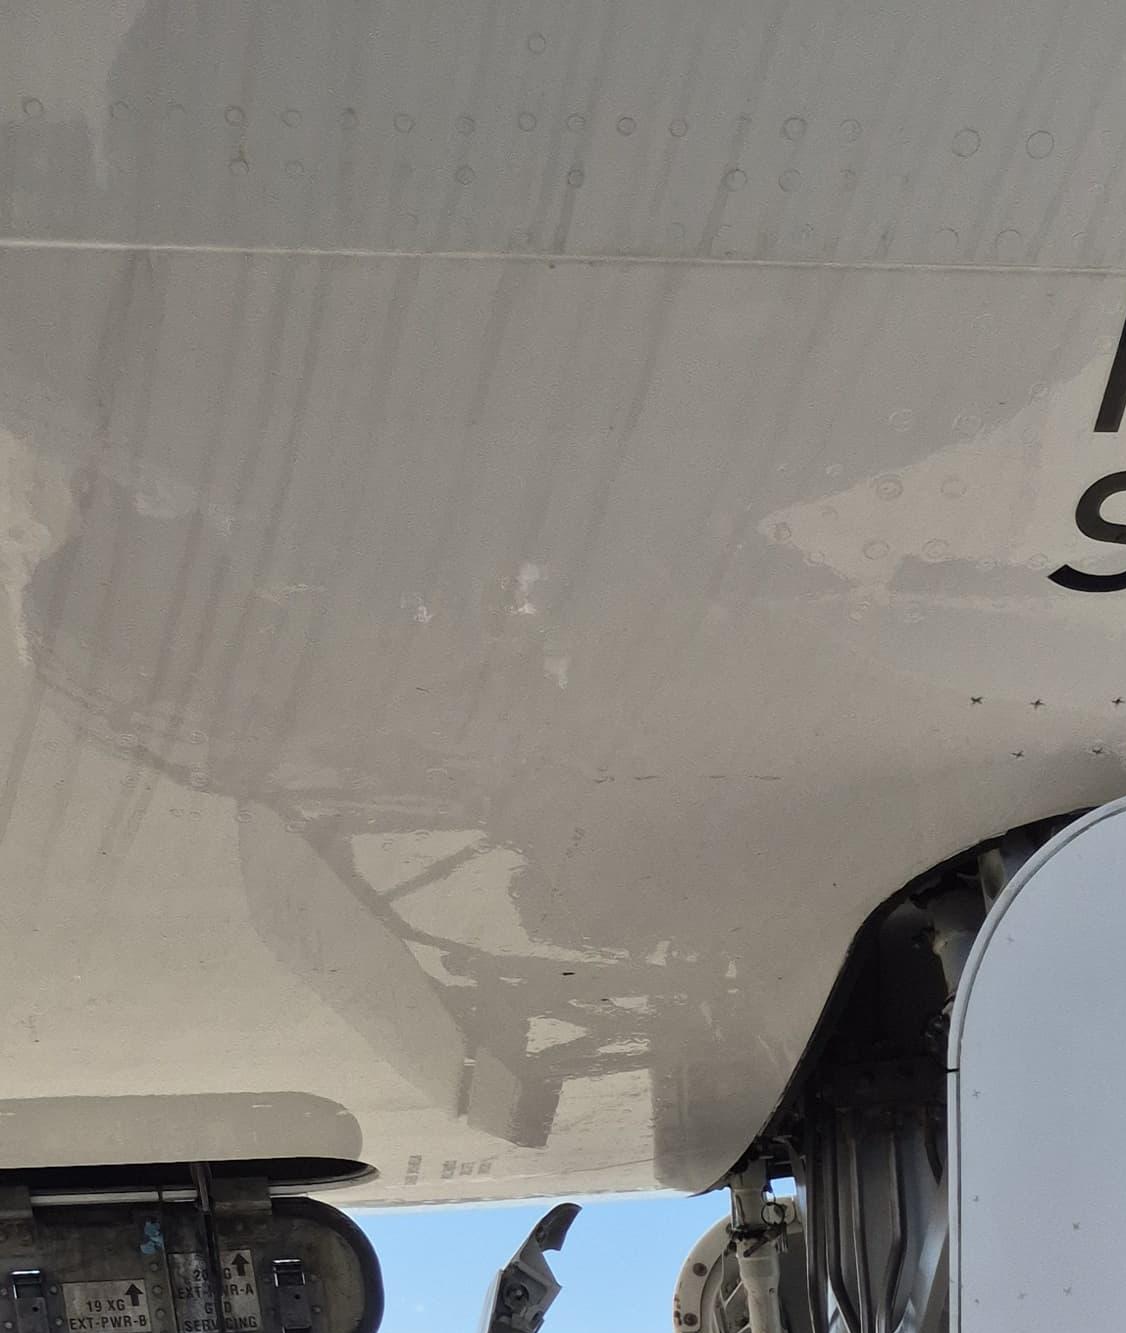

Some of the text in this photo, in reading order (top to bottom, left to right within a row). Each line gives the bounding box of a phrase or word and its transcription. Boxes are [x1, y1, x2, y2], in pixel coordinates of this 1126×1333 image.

[86, 1299, 125, 1312] 19 XG
[205, 1301, 232, 1314] GD
[70, 1315, 147, 1330] EXT-PWR-B
[184, 1316, 257, 1332] SERVCING
